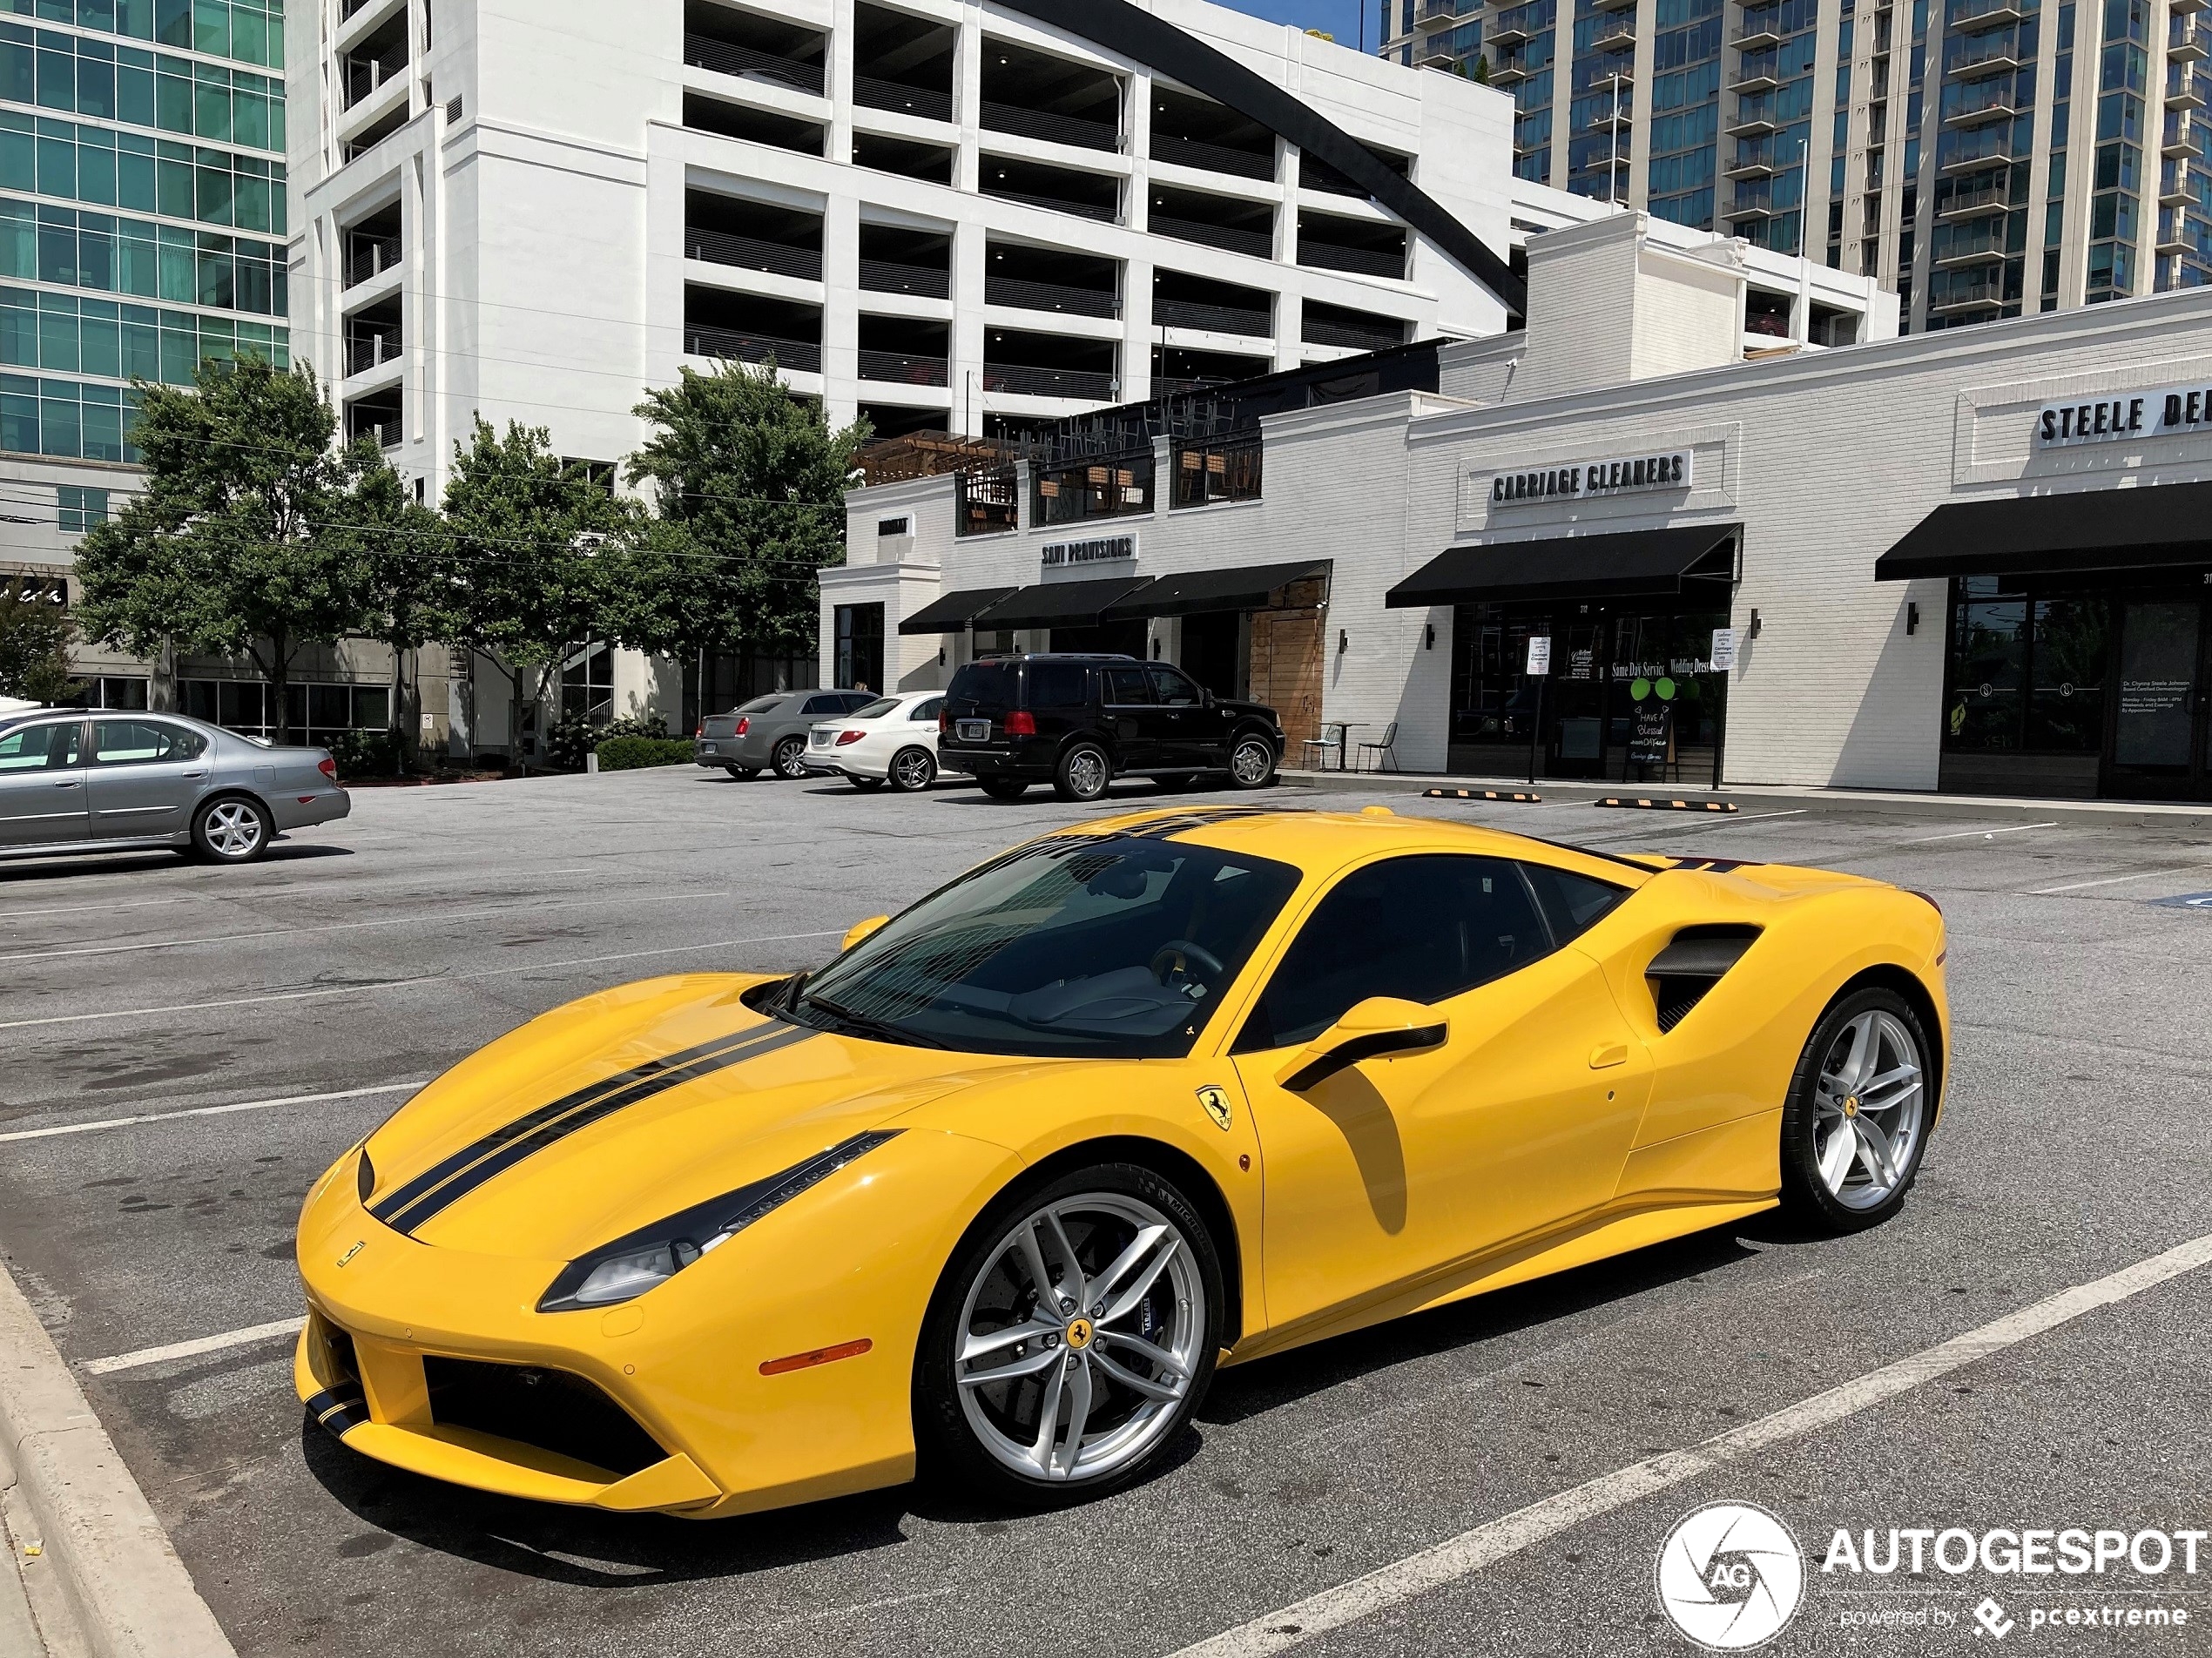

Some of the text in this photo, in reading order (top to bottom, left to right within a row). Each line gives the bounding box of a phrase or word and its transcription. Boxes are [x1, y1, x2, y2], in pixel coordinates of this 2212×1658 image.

[2041, 398, 2144, 441] STEELE
[1494, 455, 1683, 502] CARRIAGE CLEANERS
[1042, 536, 1132, 564] SAVI PROVISIONS
[1611, 662, 1665, 678] Same Day Service
[1670, 658, 1694, 677] Wedding
[1694, 657, 1710, 673] Dress
[1640, 713, 1658, 722] HAVE
[1637, 724, 1663, 735] Blessed
